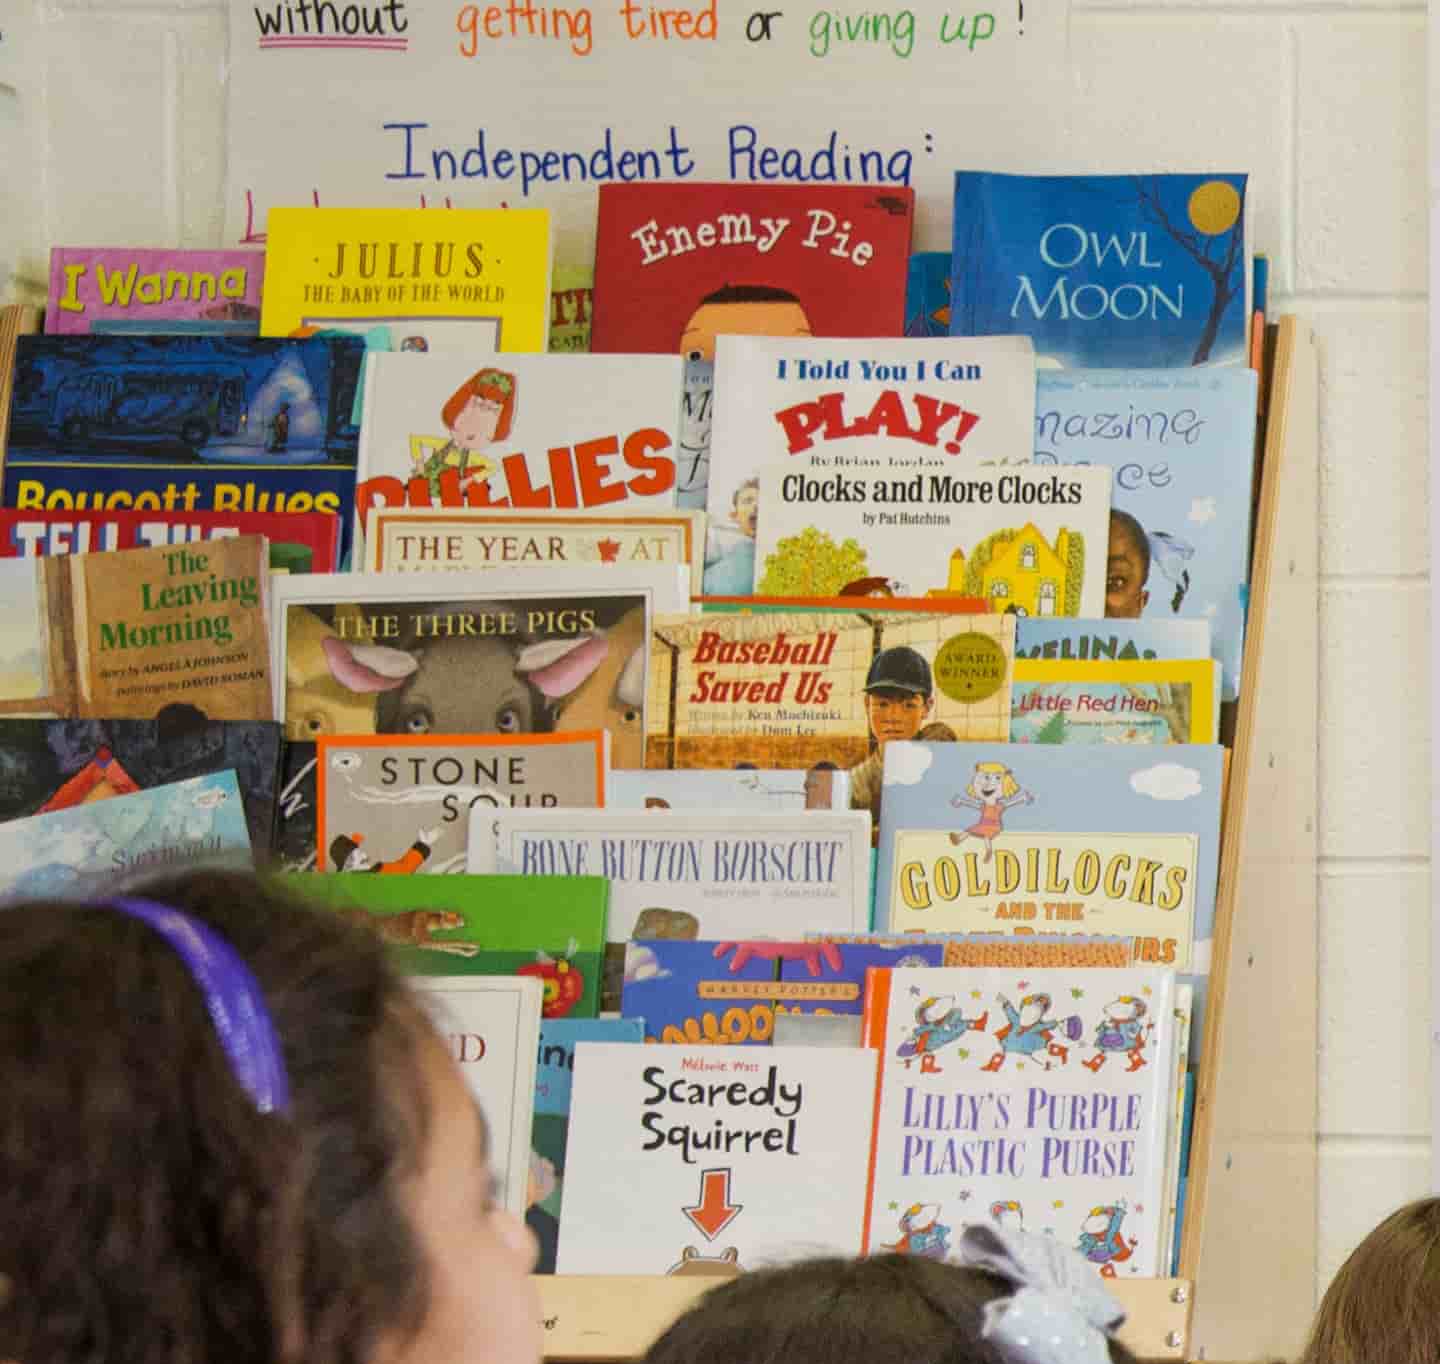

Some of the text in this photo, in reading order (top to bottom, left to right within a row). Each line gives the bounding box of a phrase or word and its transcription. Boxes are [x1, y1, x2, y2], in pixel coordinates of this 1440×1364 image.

[256, 0, 408, 35] without
[457, 0, 592, 56] getting
[621, 0, 717, 40] tired
[746, 12, 783, 41] or
[810, 8, 914, 57] giving
[383, 122, 694, 195] Independent
[632, 211, 875, 268] Enemy Pie
[1038, 224, 1161, 269] OWL
[328, 242, 484, 279] JULIUS
[61, 263, 247, 313] I Wanna
[304, 284, 505, 305] THE BABY OF THE WORLD
[1010, 276, 1183, 321] MOON
[777, 359, 982, 381] I Told You I Can
[774, 389, 981, 456] PLAY!
[1036, 404, 1207, 445] azing
[782, 474, 1082, 505] Clocks and More Clocks
[863, 511, 950, 526] by Pat Hutchins
[162, 551, 208, 576] The
[397, 535, 671, 560] THE YEAR AT
[142, 574, 259, 611] Leaving
[100, 612, 233, 651] Morning
[334, 609, 596, 639] THE THREE PIGS
[692, 629, 838, 665] Baseball
[945, 652, 998, 664] AWARD
[690, 671, 832, 705] Saved Us
[940, 666, 1000, 679] WINNER
[1020, 693, 1160, 712] Little Red Hen
[381, 757, 526, 785] STONE
[522, 838, 590, 876] BONE
[600, 838, 705, 882] BUTTON
[900, 848, 1187, 911] GOLDILOCKS
[995, 902, 1085, 920] AND THE
[642, 1065, 802, 1117] Scaredy
[903, 1086, 1143, 1131] LILLY'S PURPLE
[641, 1112, 799, 1164] Squirrel
[903, 1136, 1135, 1178] PLASTIC PURSE
